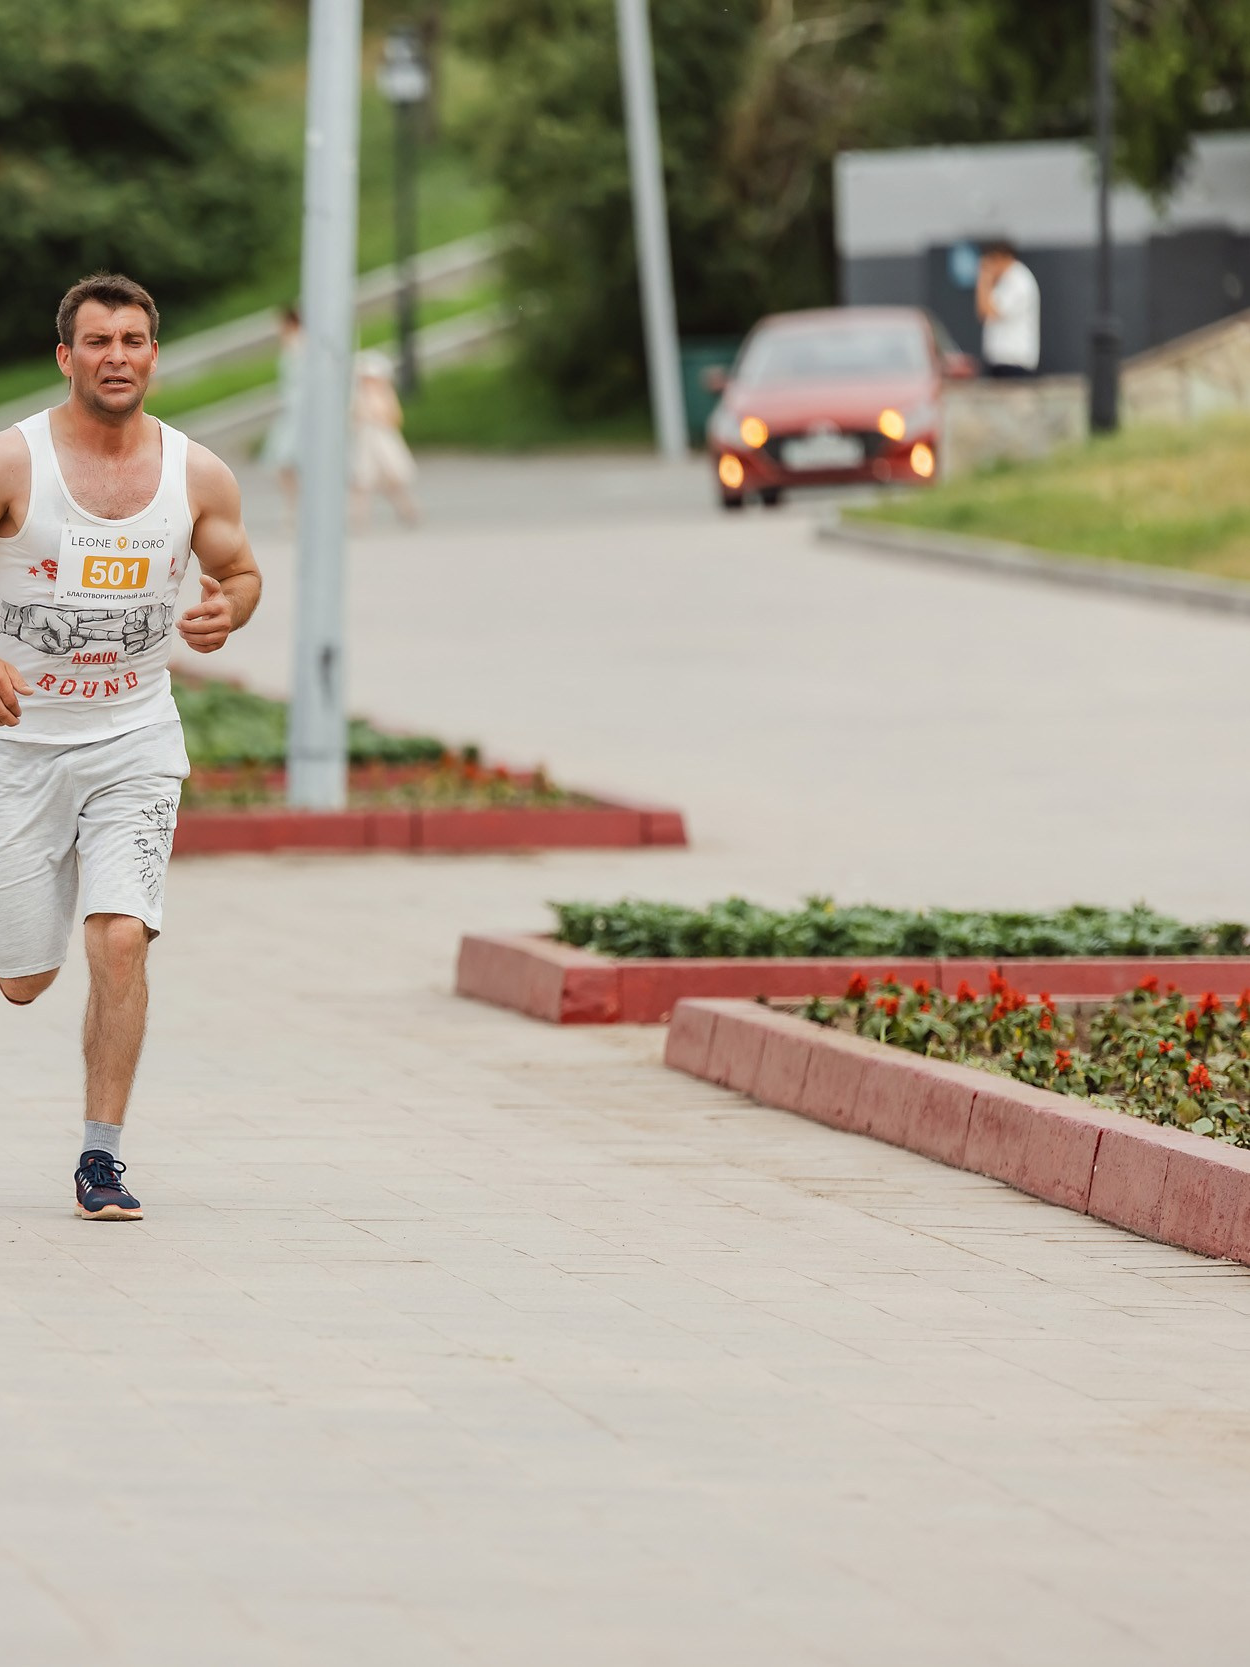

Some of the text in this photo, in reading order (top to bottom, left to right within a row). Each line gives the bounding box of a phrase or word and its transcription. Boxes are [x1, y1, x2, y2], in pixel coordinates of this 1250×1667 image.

[71, 537, 165, 549] LEONE D'ORO
[89, 560, 140, 586] 501
[66, 591, 138, 600] БЛАГОТВОРИТЕЛЬНЫЙ
[71, 651, 118, 664] AGAIN
[36, 671, 139, 698] ROUND
